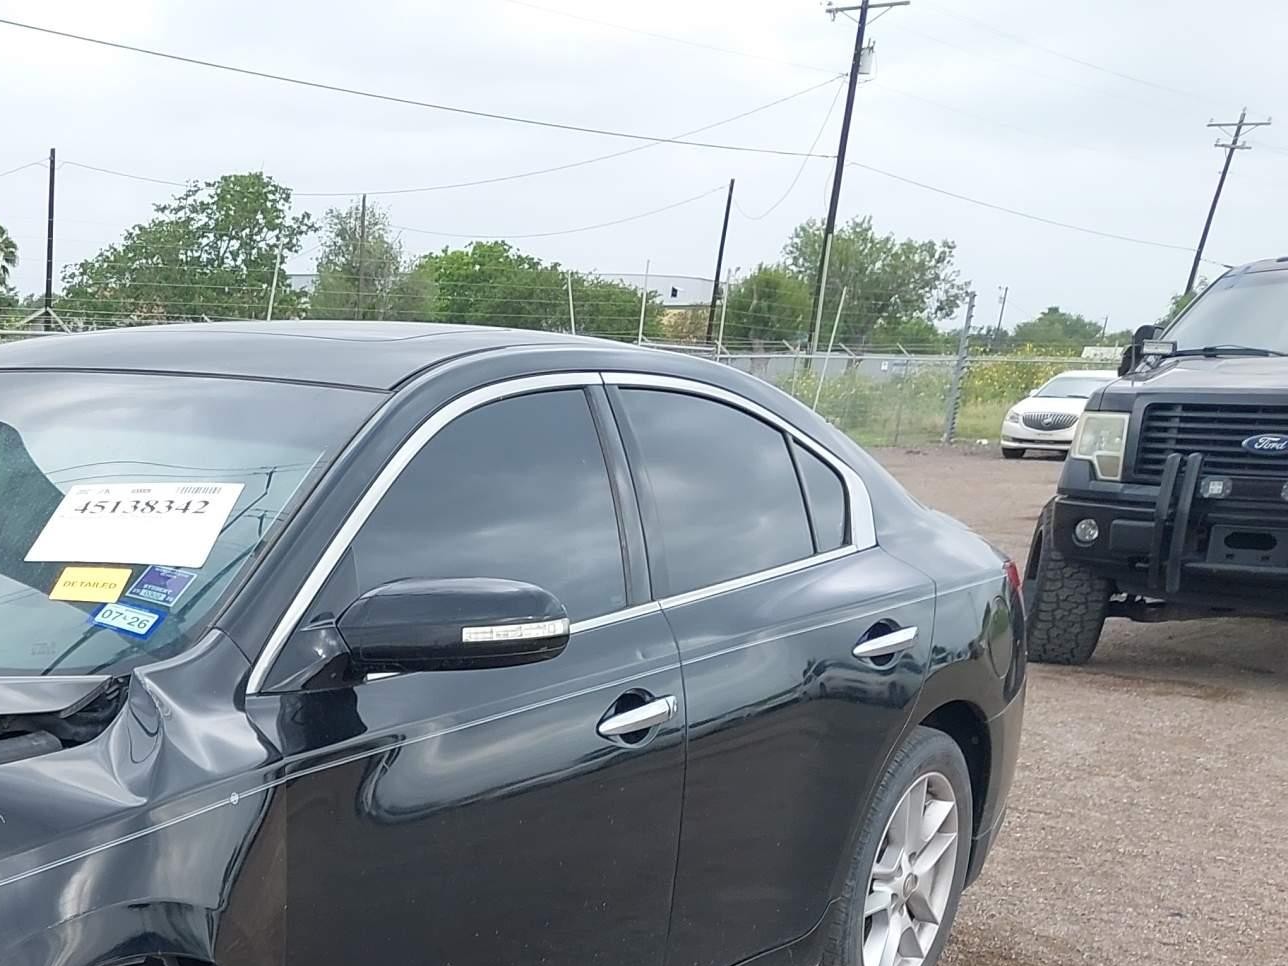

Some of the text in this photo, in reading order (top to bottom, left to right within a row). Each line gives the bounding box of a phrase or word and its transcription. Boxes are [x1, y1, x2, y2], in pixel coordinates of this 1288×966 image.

[1254, 437, 1288, 449] Ford
[74, 499, 210, 514] 45138342
[63, 580, 118, 590] DETAILED
